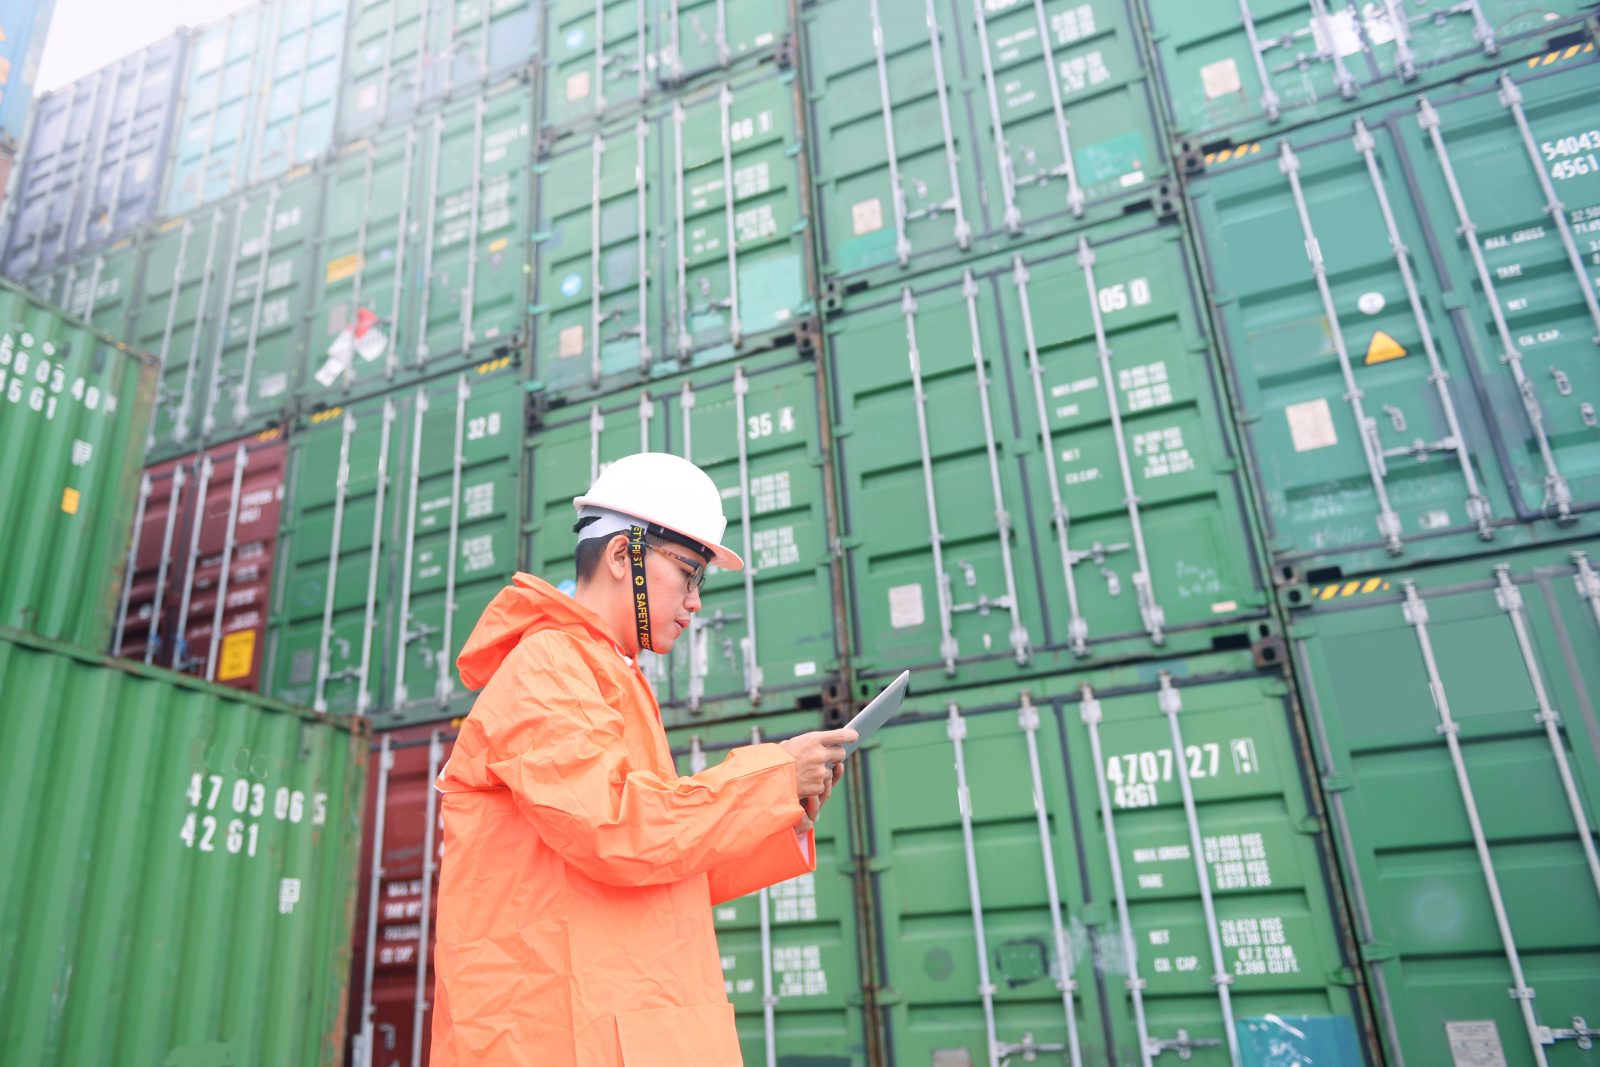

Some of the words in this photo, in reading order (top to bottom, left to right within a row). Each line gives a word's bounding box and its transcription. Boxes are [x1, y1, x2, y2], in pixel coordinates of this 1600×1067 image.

[636, 592, 649, 631] SAFETY
[1107, 749, 1173, 787] 4707
[1186, 743, 1221, 779] 27
